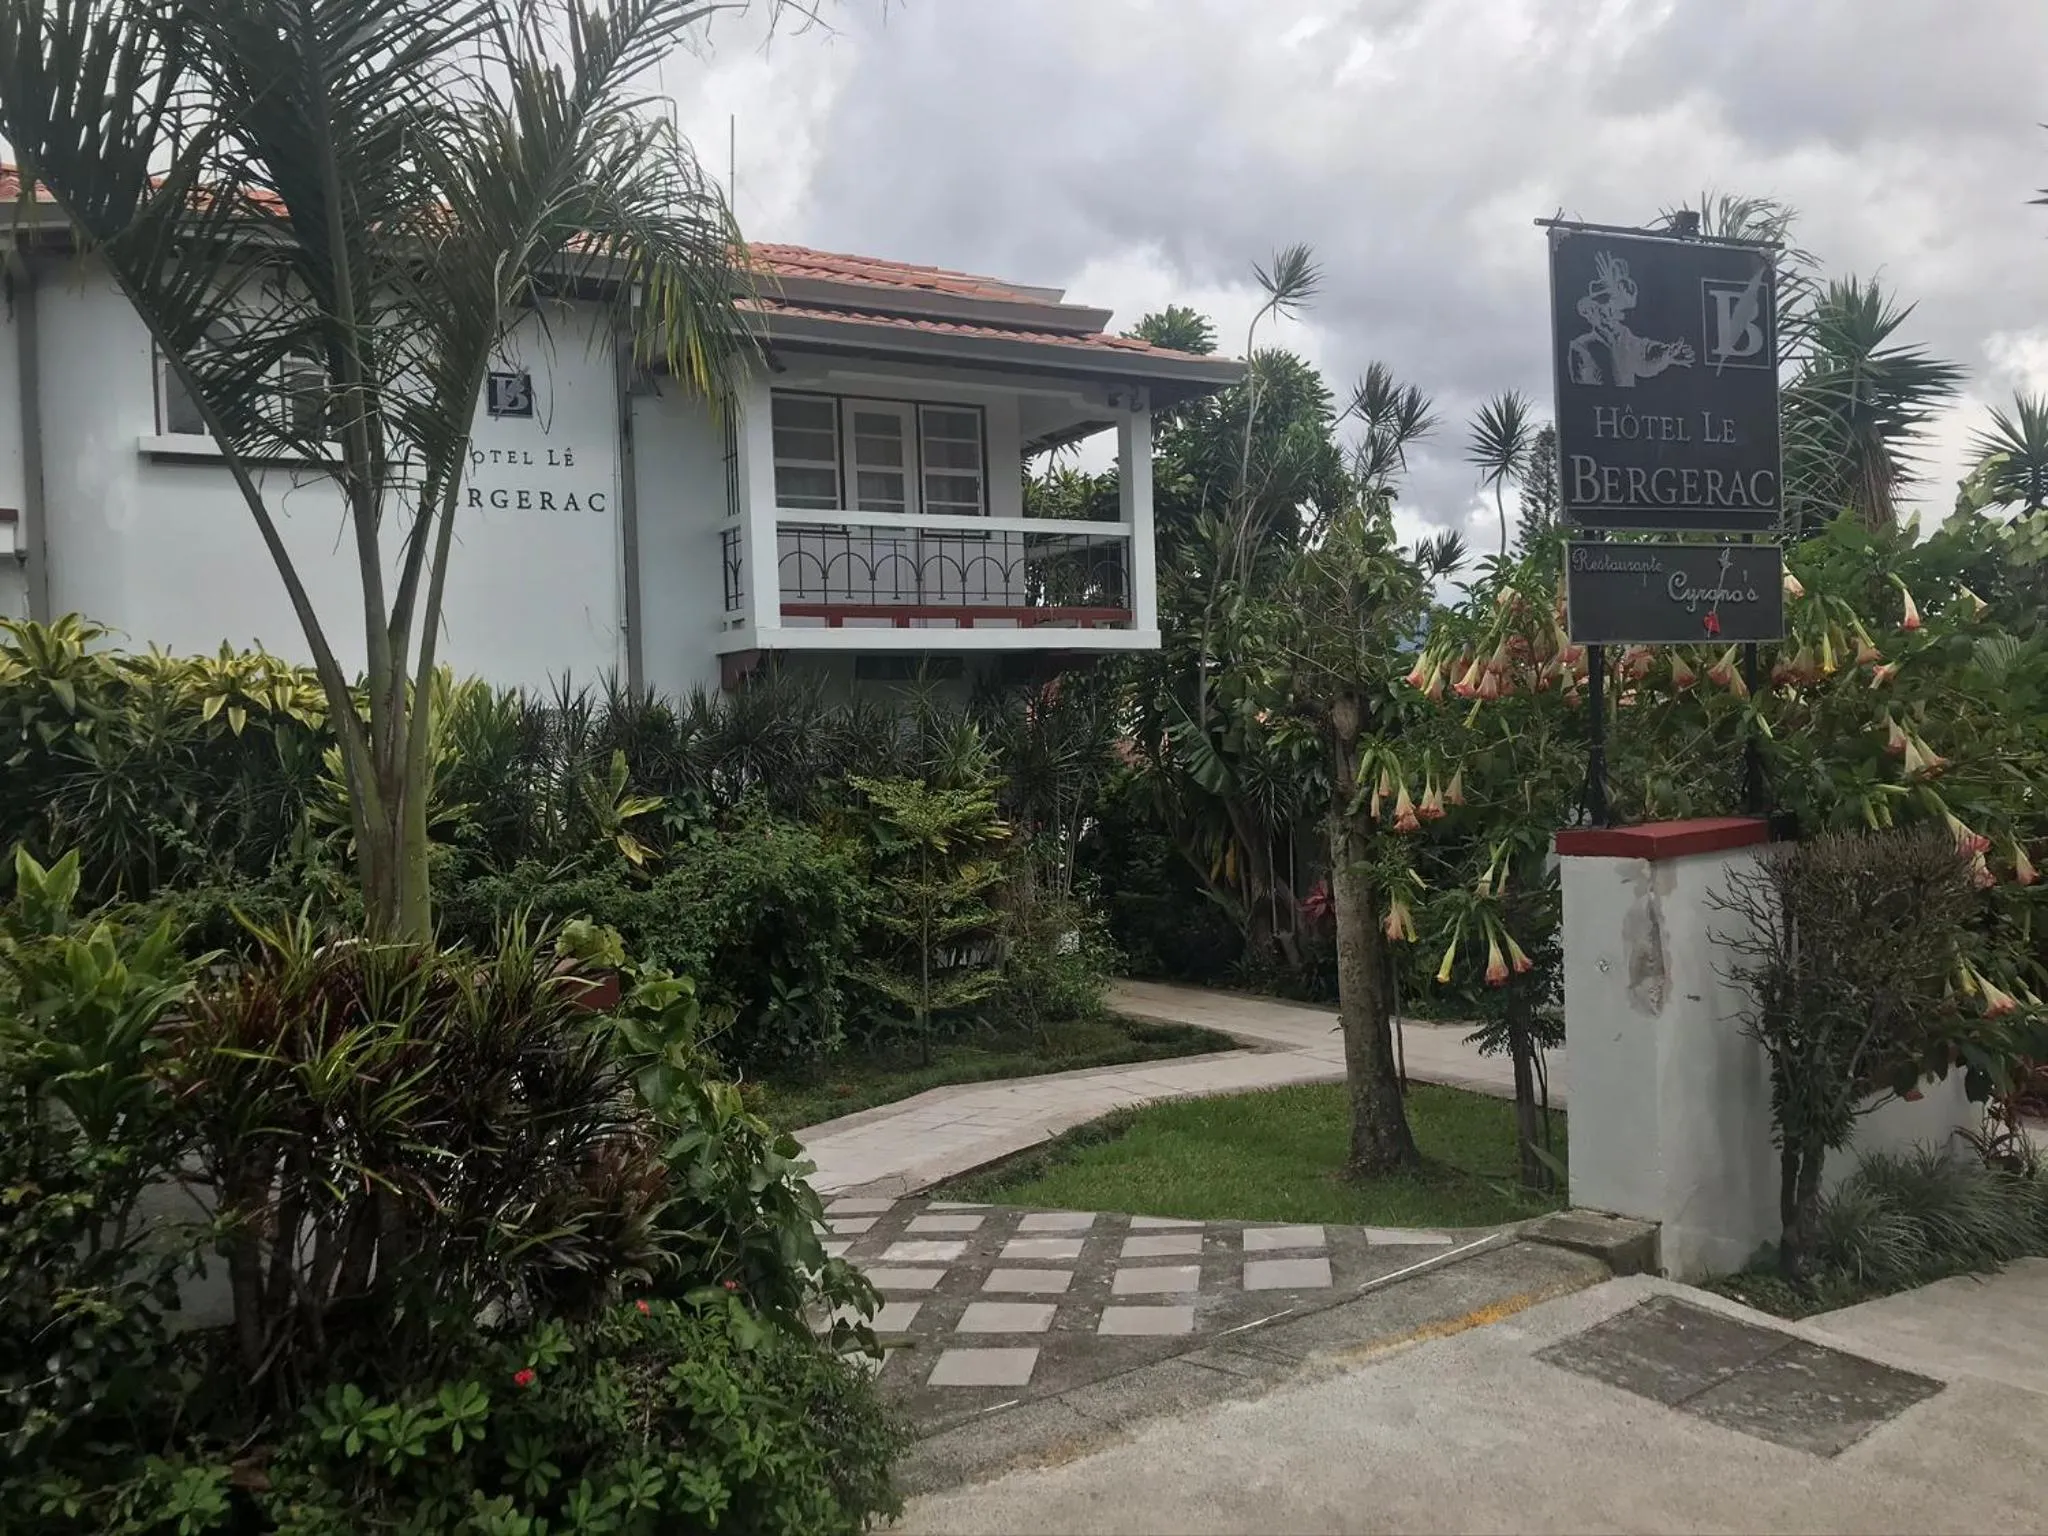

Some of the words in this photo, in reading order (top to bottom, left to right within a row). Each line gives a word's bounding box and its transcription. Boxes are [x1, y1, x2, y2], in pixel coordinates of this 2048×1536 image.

[1592, 403, 1691, 442] HÔTEL
[1702, 410, 1736, 443] LE
[470, 450, 533, 466] OTEL
[455, 487, 606, 512] RGERAC
[1569, 454, 1775, 507] BERGERAC
[1668, 569, 1760, 613] Cyrano's
